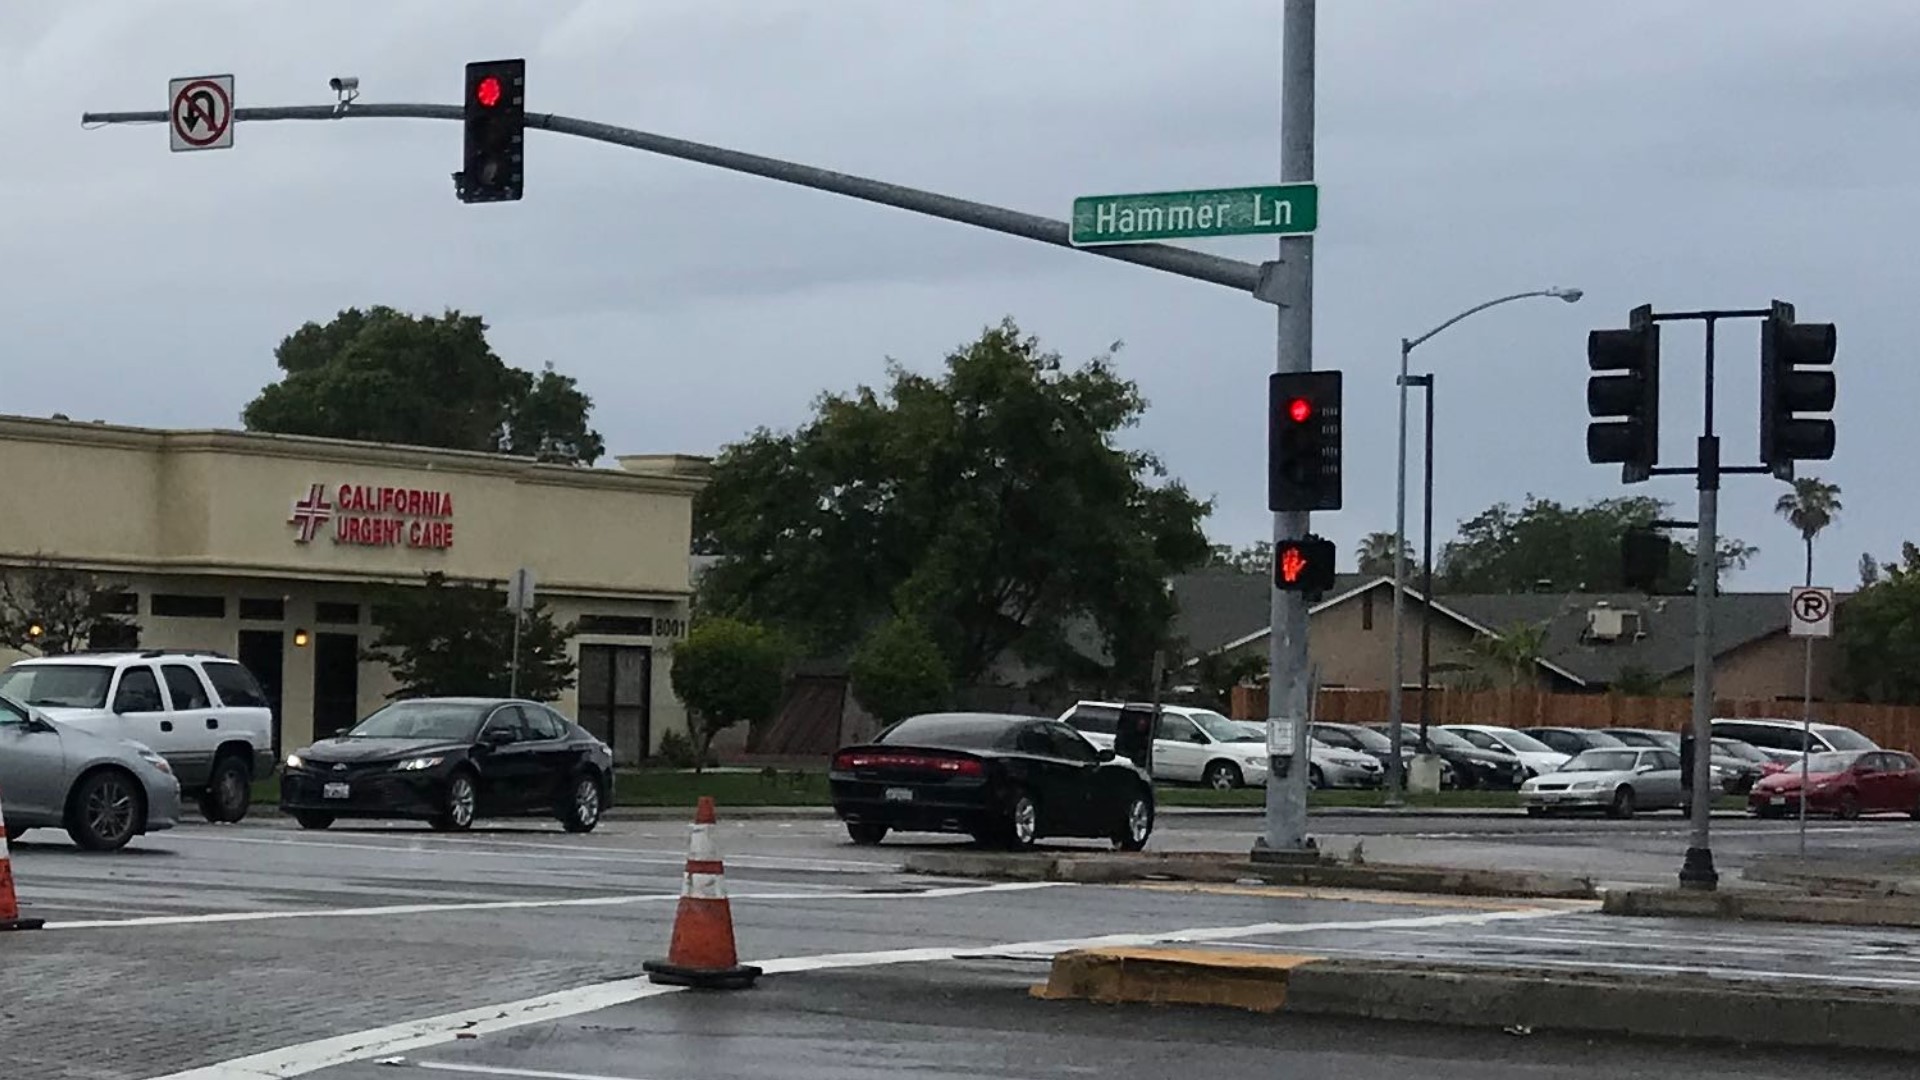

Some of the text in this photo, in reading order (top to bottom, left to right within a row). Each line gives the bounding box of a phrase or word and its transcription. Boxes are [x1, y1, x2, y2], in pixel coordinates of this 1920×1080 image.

[1096, 194, 1292, 234] Hammer Ln
[338, 484, 453, 517] CALIFORNIA
[337, 516, 453, 547] URGENT CARE
[656, 618, 686, 639] 8001
